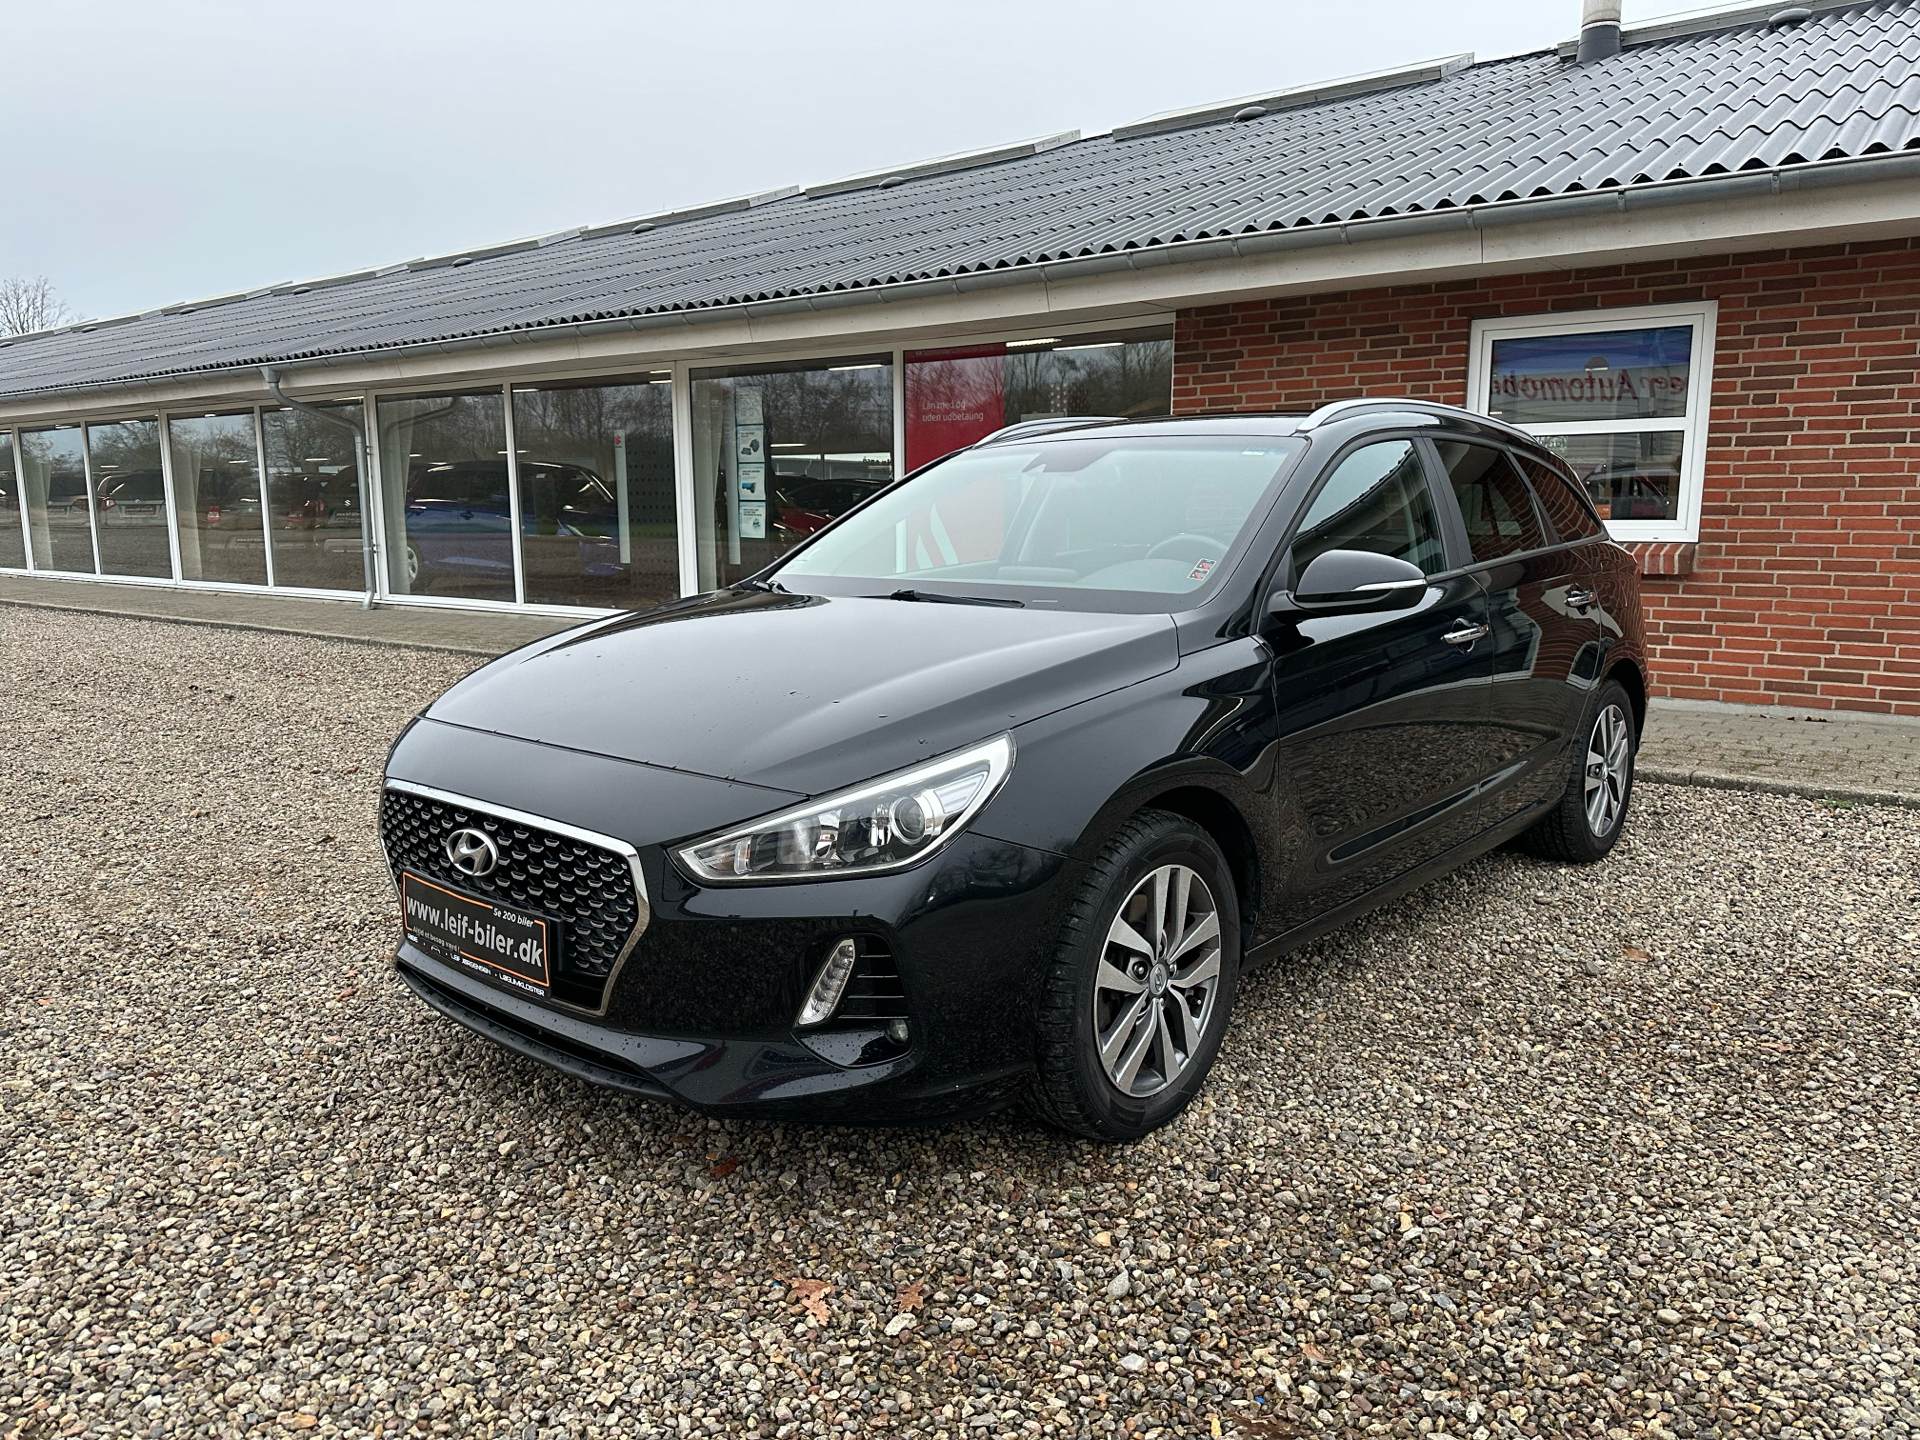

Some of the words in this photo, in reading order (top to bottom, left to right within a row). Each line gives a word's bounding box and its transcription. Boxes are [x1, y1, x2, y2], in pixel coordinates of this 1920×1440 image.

[955, 401, 966, 411] og
[922, 413, 941, 422] uden
[942, 411, 984, 422] udbetaling
[493, 907, 502, 917] Se
[502, 910, 516, 923] 200
[517, 914, 534, 928] biler
[406, 896, 543, 967] www.leif-biler.dk
